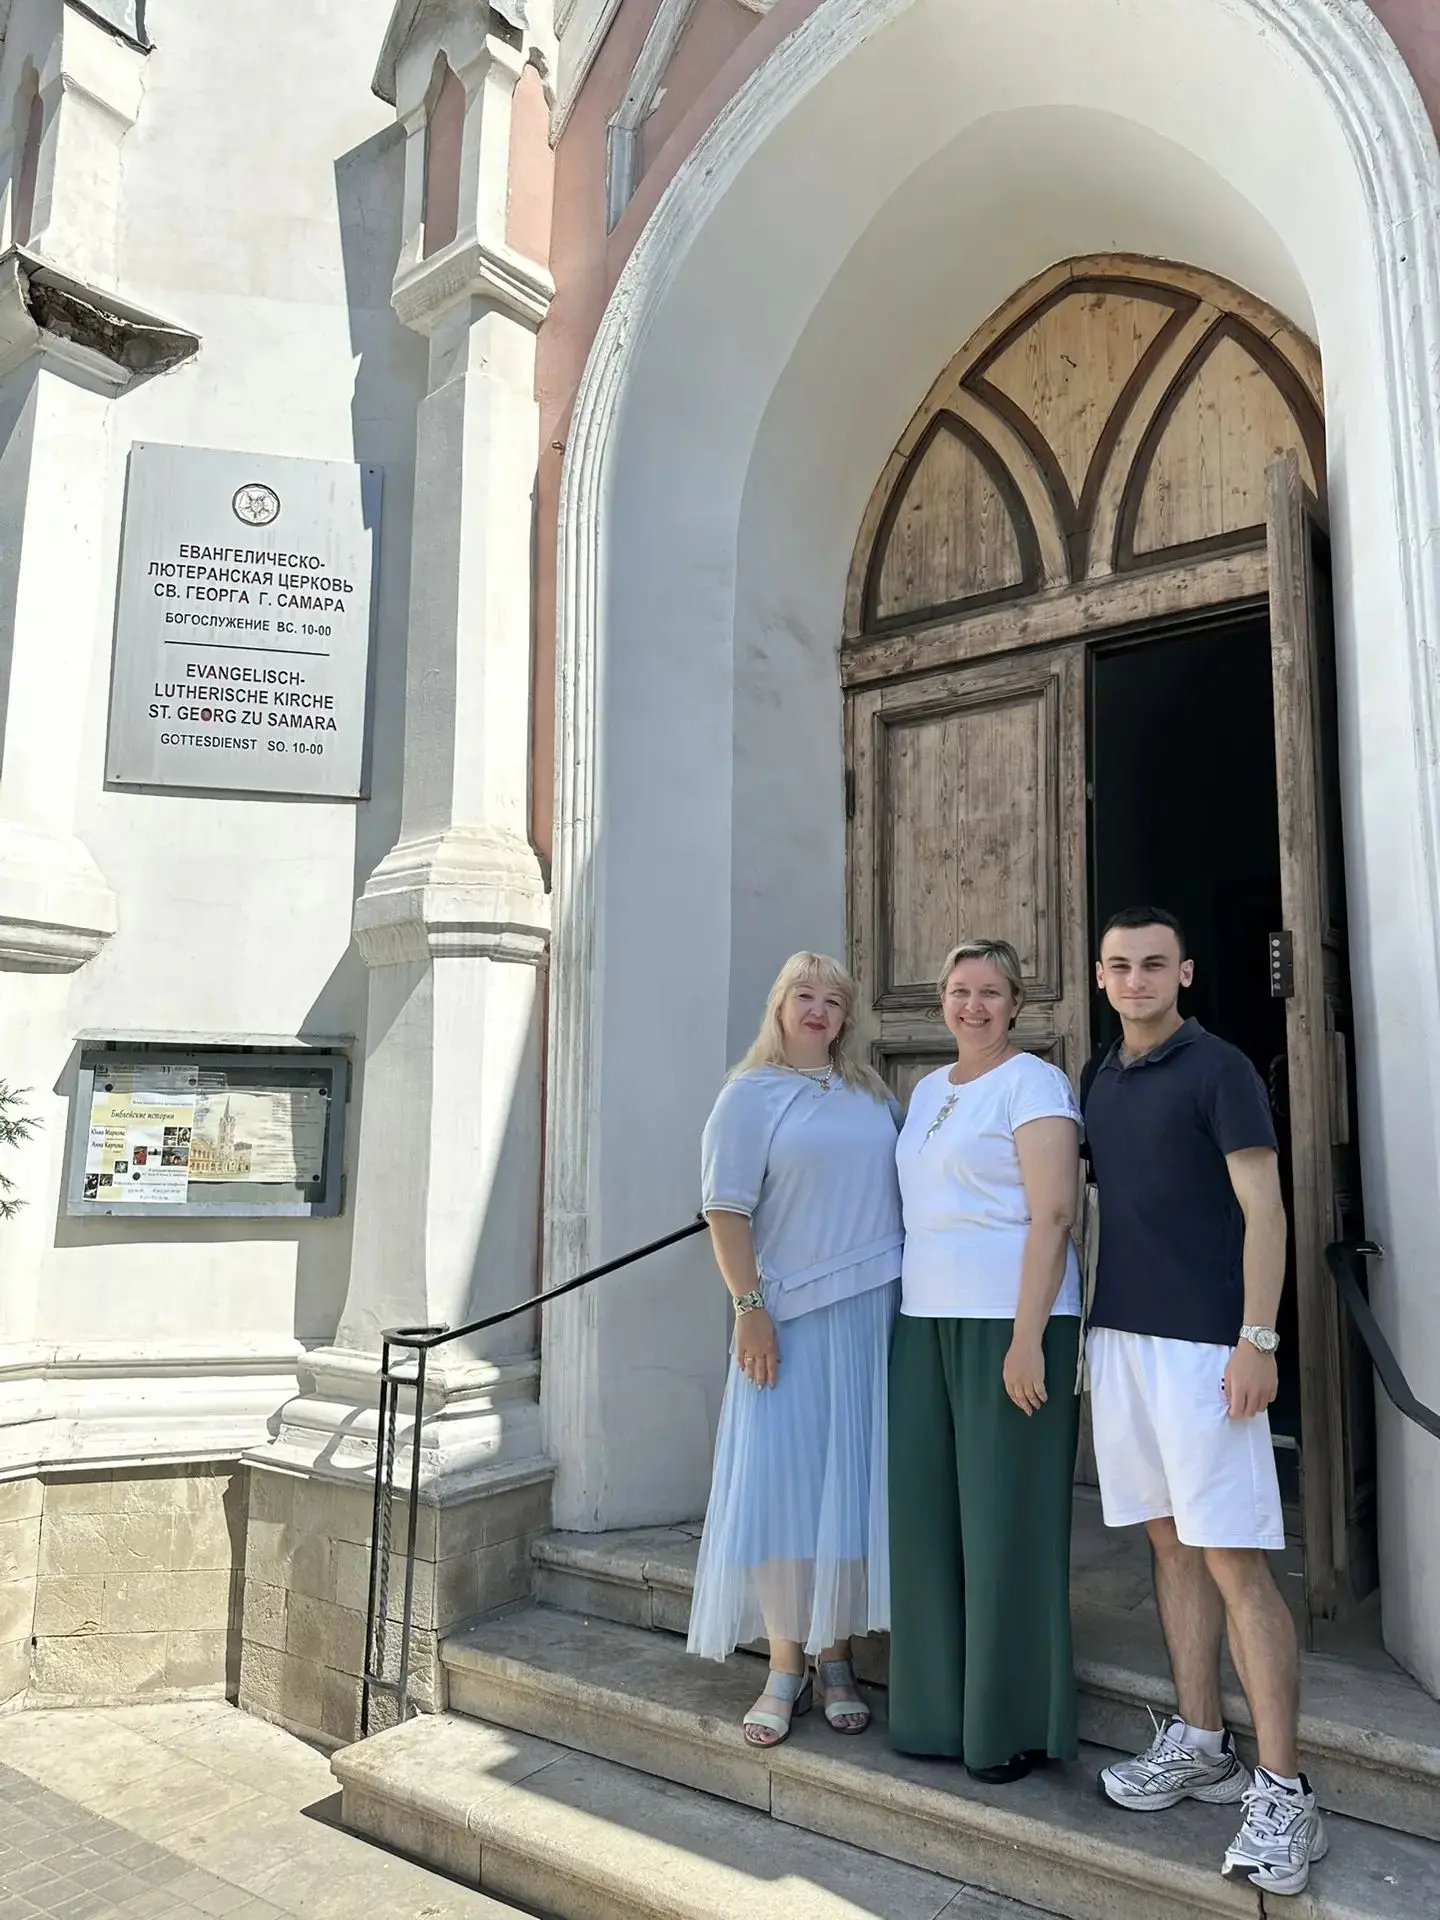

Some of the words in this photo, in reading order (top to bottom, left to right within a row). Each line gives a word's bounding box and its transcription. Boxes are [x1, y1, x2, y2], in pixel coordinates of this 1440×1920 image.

[179, 544, 325, 570] ЕВАНГЕЛИЧЕСКО-
[148, 562, 273, 586] ЛЮТЕРАНСКАЯ
[278, 573, 354, 593] ЦЕРКОВЬ
[154, 583, 180, 598] СВ.
[186, 585, 250, 604] ГЕОРГА
[259, 592, 272, 606] Г.
[277, 594, 345, 612] САМАРА
[165, 612, 270, 631] БОГОСЛУЖЕНИЕ
[277, 621, 297, 634] ВС.
[301, 624, 332, 637] 10-00
[186, 664, 305, 686] EVANGELISCH-
[154, 683, 268, 705] LUTHERISCHE
[274, 691, 334, 709] KIRCHE
[149, 704, 171, 719] ST.
[177, 706, 237, 724] GEORG
[240, 711, 263, 725] ZU
[267, 713, 337, 731] SAMARA
[160, 733, 257, 750] GOTTESDIENST
[267, 740, 288, 753] SO.
[292, 742, 323, 755] 10-00
[110, 1109, 147, 1120] Библейские
[147, 1113, 175, 1121] истории
